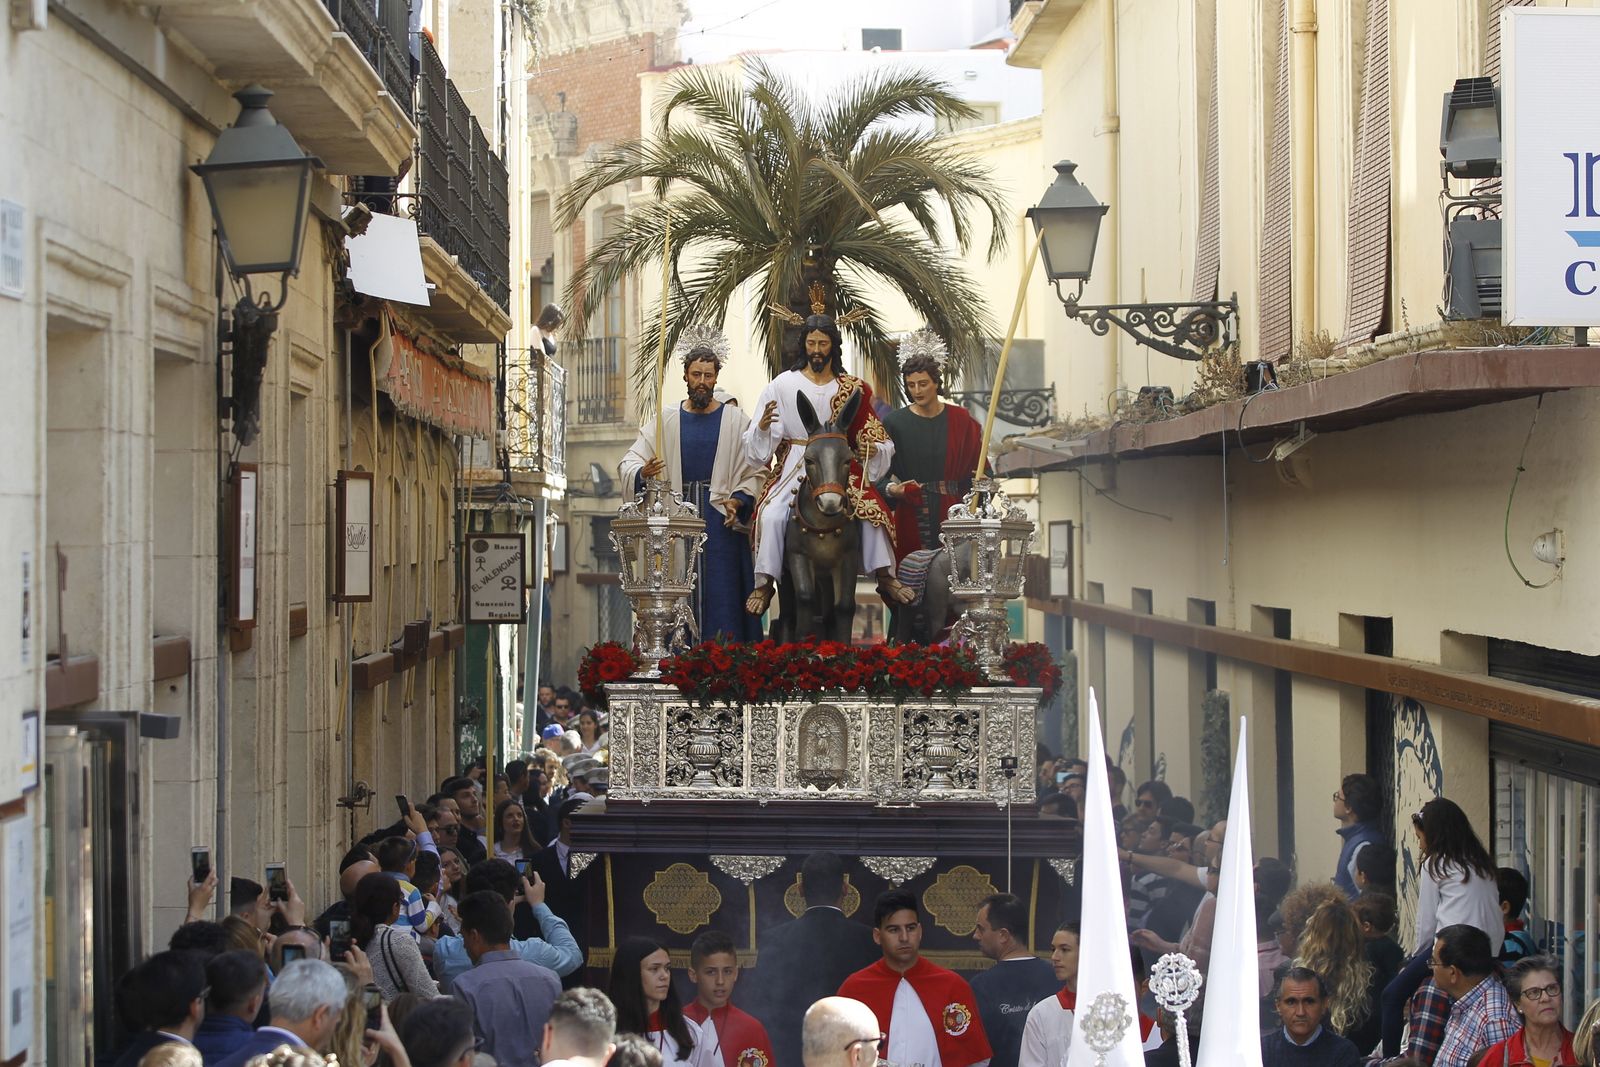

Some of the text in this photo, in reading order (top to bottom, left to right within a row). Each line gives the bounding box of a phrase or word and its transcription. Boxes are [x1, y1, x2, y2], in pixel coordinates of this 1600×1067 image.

[471, 551, 521, 593] EL VALENCIANO
[488, 611, 519, 620] Regalos
